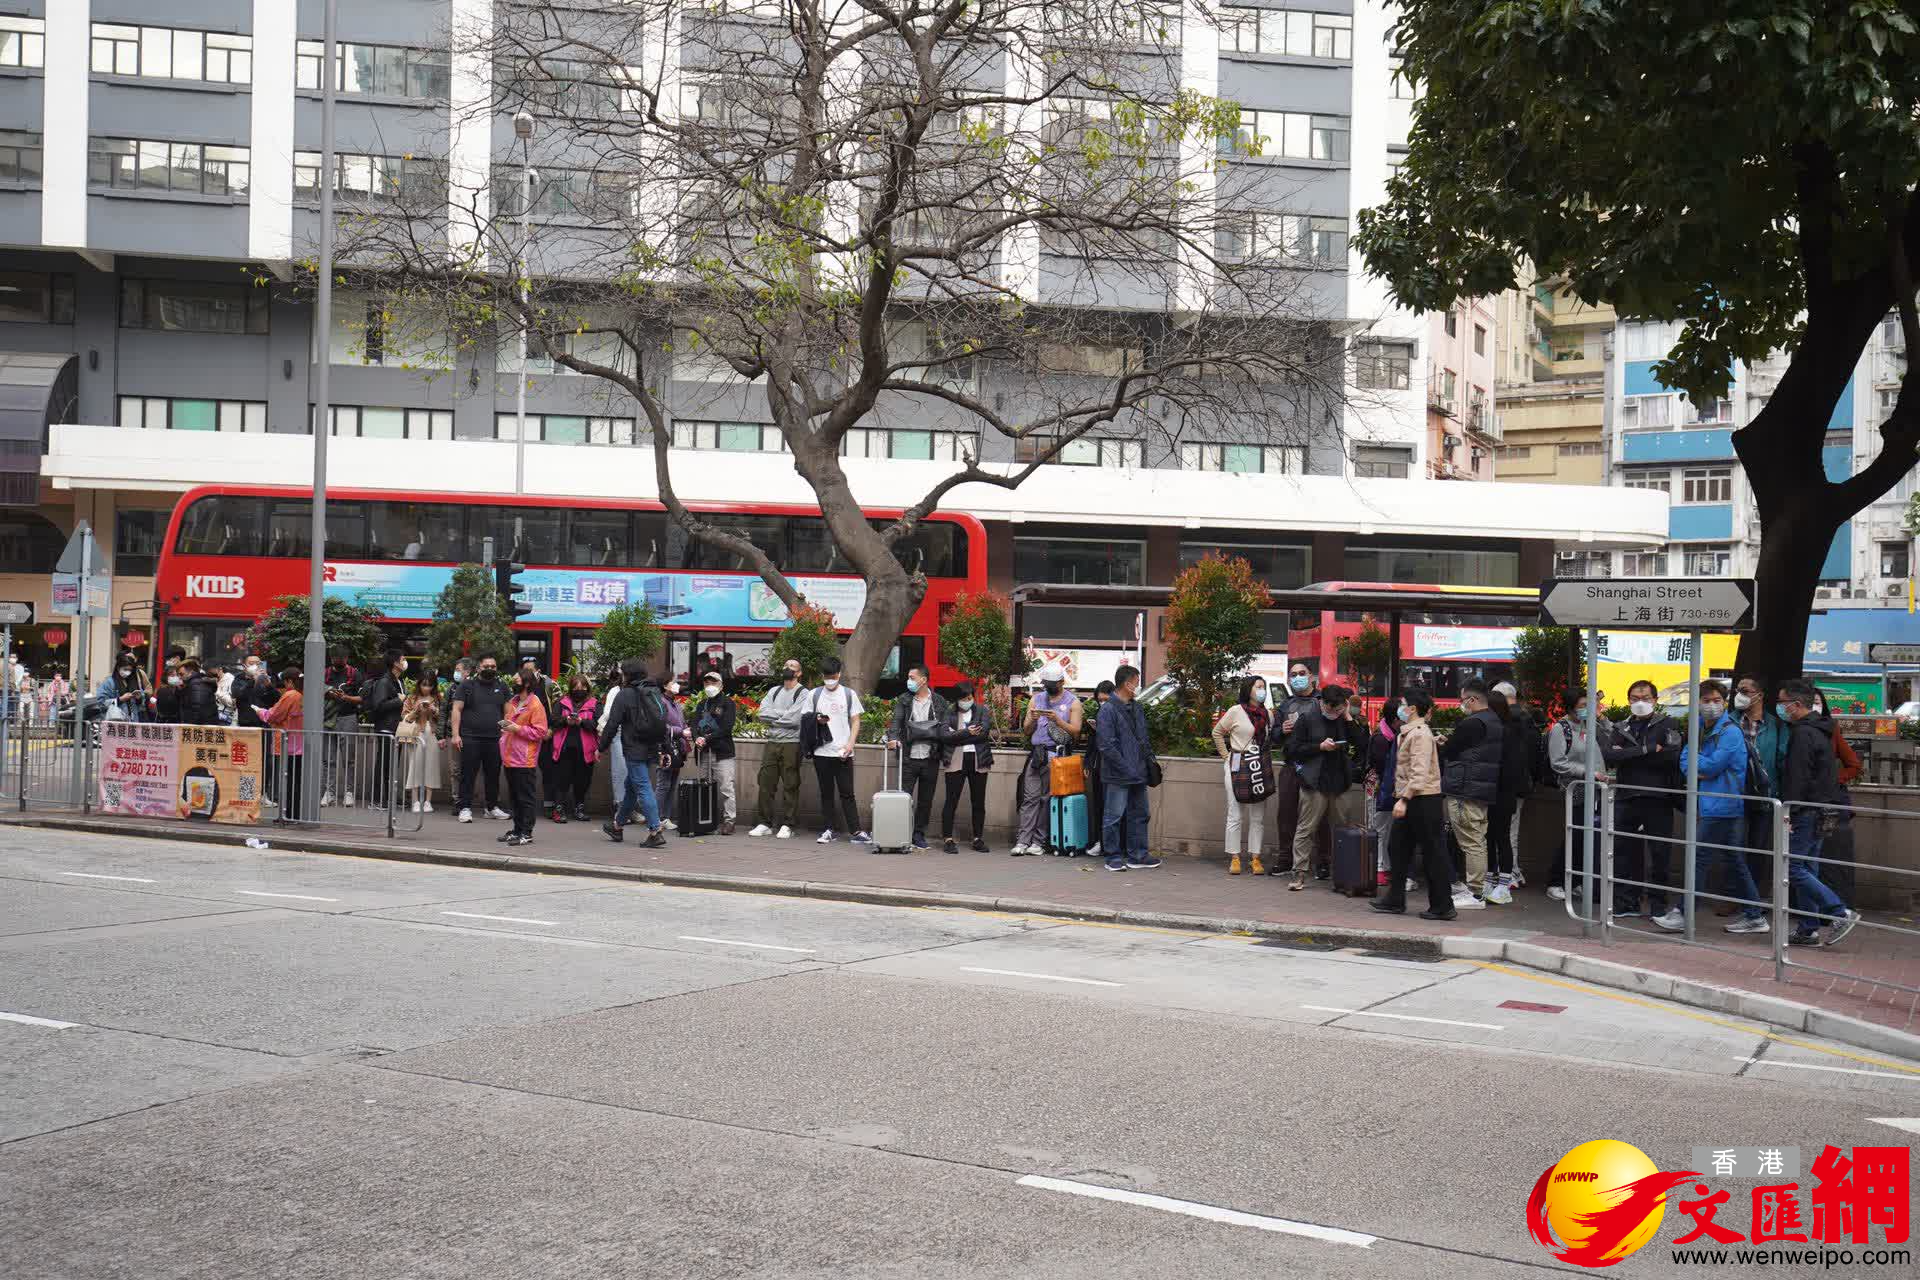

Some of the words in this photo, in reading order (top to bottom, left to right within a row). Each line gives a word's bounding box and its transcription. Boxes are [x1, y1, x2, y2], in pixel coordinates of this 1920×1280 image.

[186, 575, 245, 598] KMB
[1587, 587, 1651, 600] Shanghai
[1657, 586, 1702, 598] Street
[1612, 606, 1674, 621] 上海街
[1680, 609, 1730, 618] 730-696
[120, 762, 143, 775] 2780
[145, 764, 169, 777] 2211
